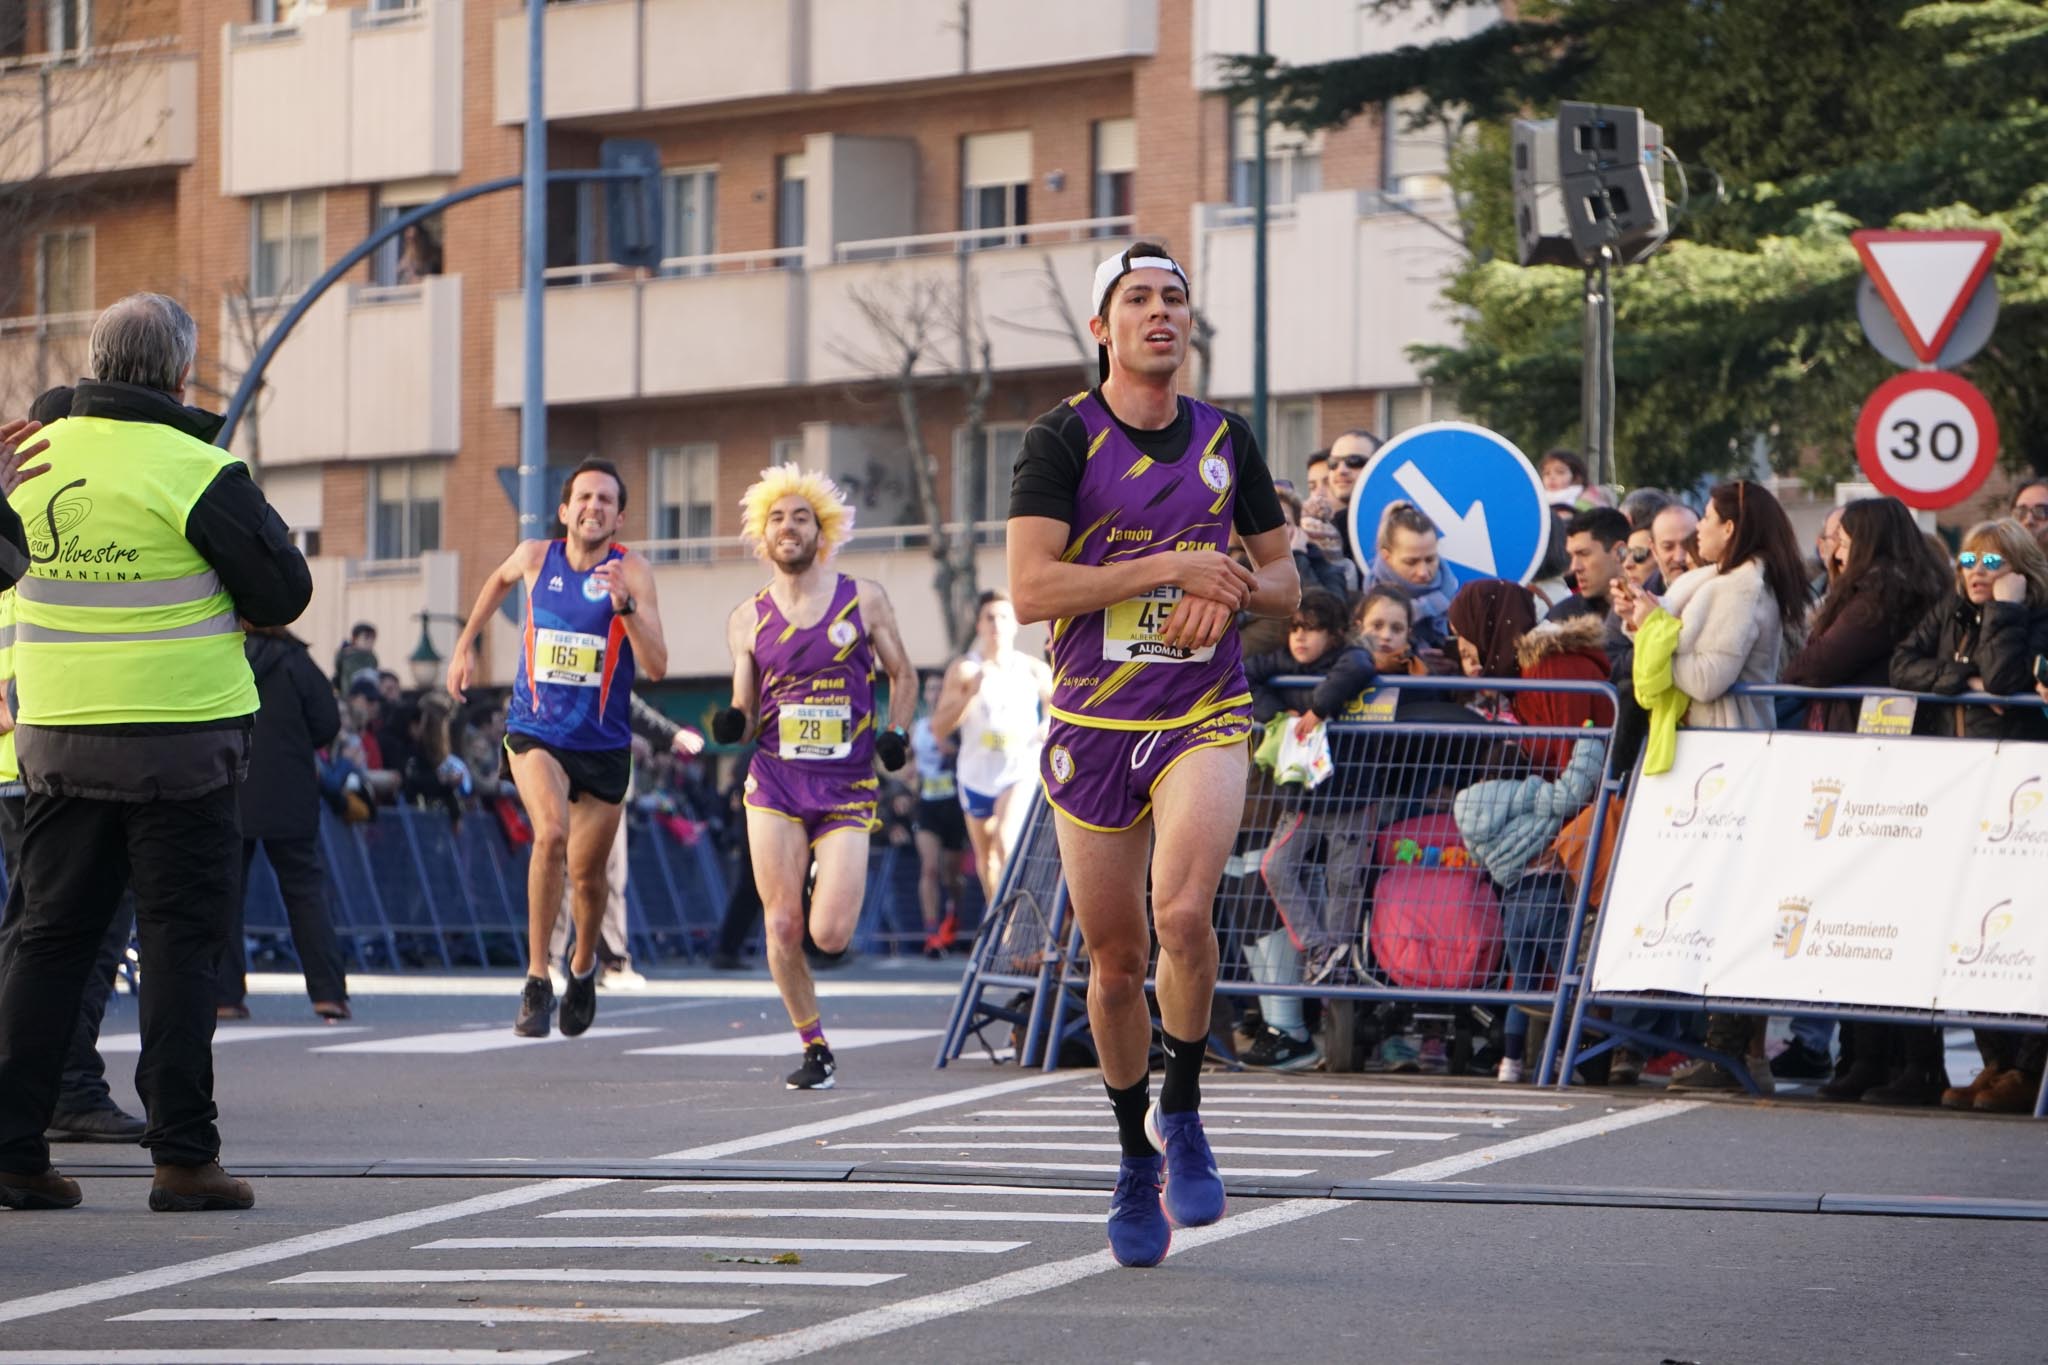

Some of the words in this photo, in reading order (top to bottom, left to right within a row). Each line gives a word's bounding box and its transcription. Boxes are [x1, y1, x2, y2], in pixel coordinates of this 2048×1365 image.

[1891, 420, 1963, 462] 30
[32, 478, 139, 564] Silvestre
[1107, 526, 1153, 543] Jamón
[29, 567, 142, 581] ALMANTINA
[1130, 633, 1163, 641] ALBERTO
[551, 645, 577, 666] 165
[1139, 644, 1183, 658] ALJOMAR
[799, 719, 820, 740] 28
[1843, 801, 1928, 818] Ayuntamiento
[1838, 822, 1853, 837] de
[1857, 823, 1923, 839] Salamanca
[1813, 919, 1898, 938] Ayuntamiento
[1807, 942, 1821, 956] de
[1826, 941, 1894, 960] Salamanca
